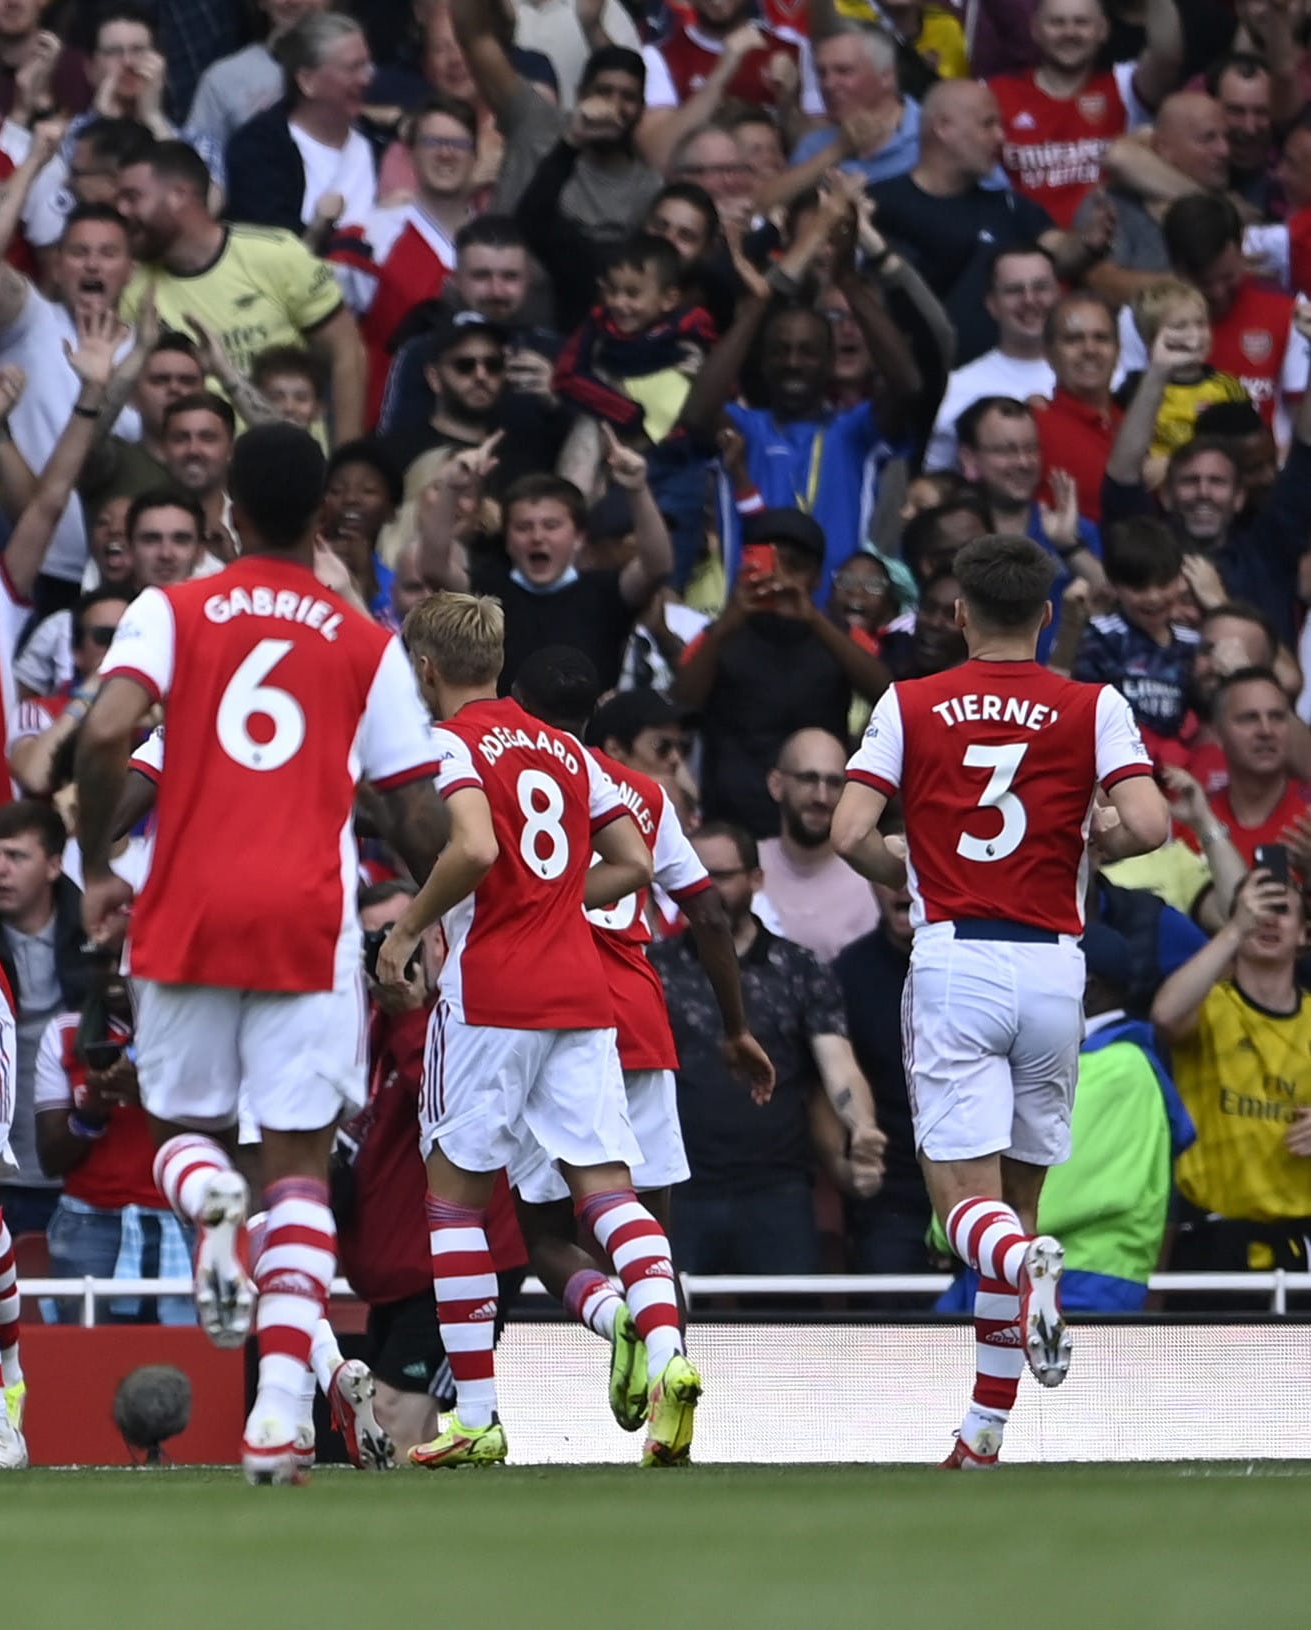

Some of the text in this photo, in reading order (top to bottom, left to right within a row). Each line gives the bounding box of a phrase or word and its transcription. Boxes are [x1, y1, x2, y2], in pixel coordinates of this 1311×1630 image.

[204, 586, 344, 642] GABRIEL
[216, 637, 306, 771] 6
[517, 769, 569, 880] 8
[956, 742, 1029, 863] 3
